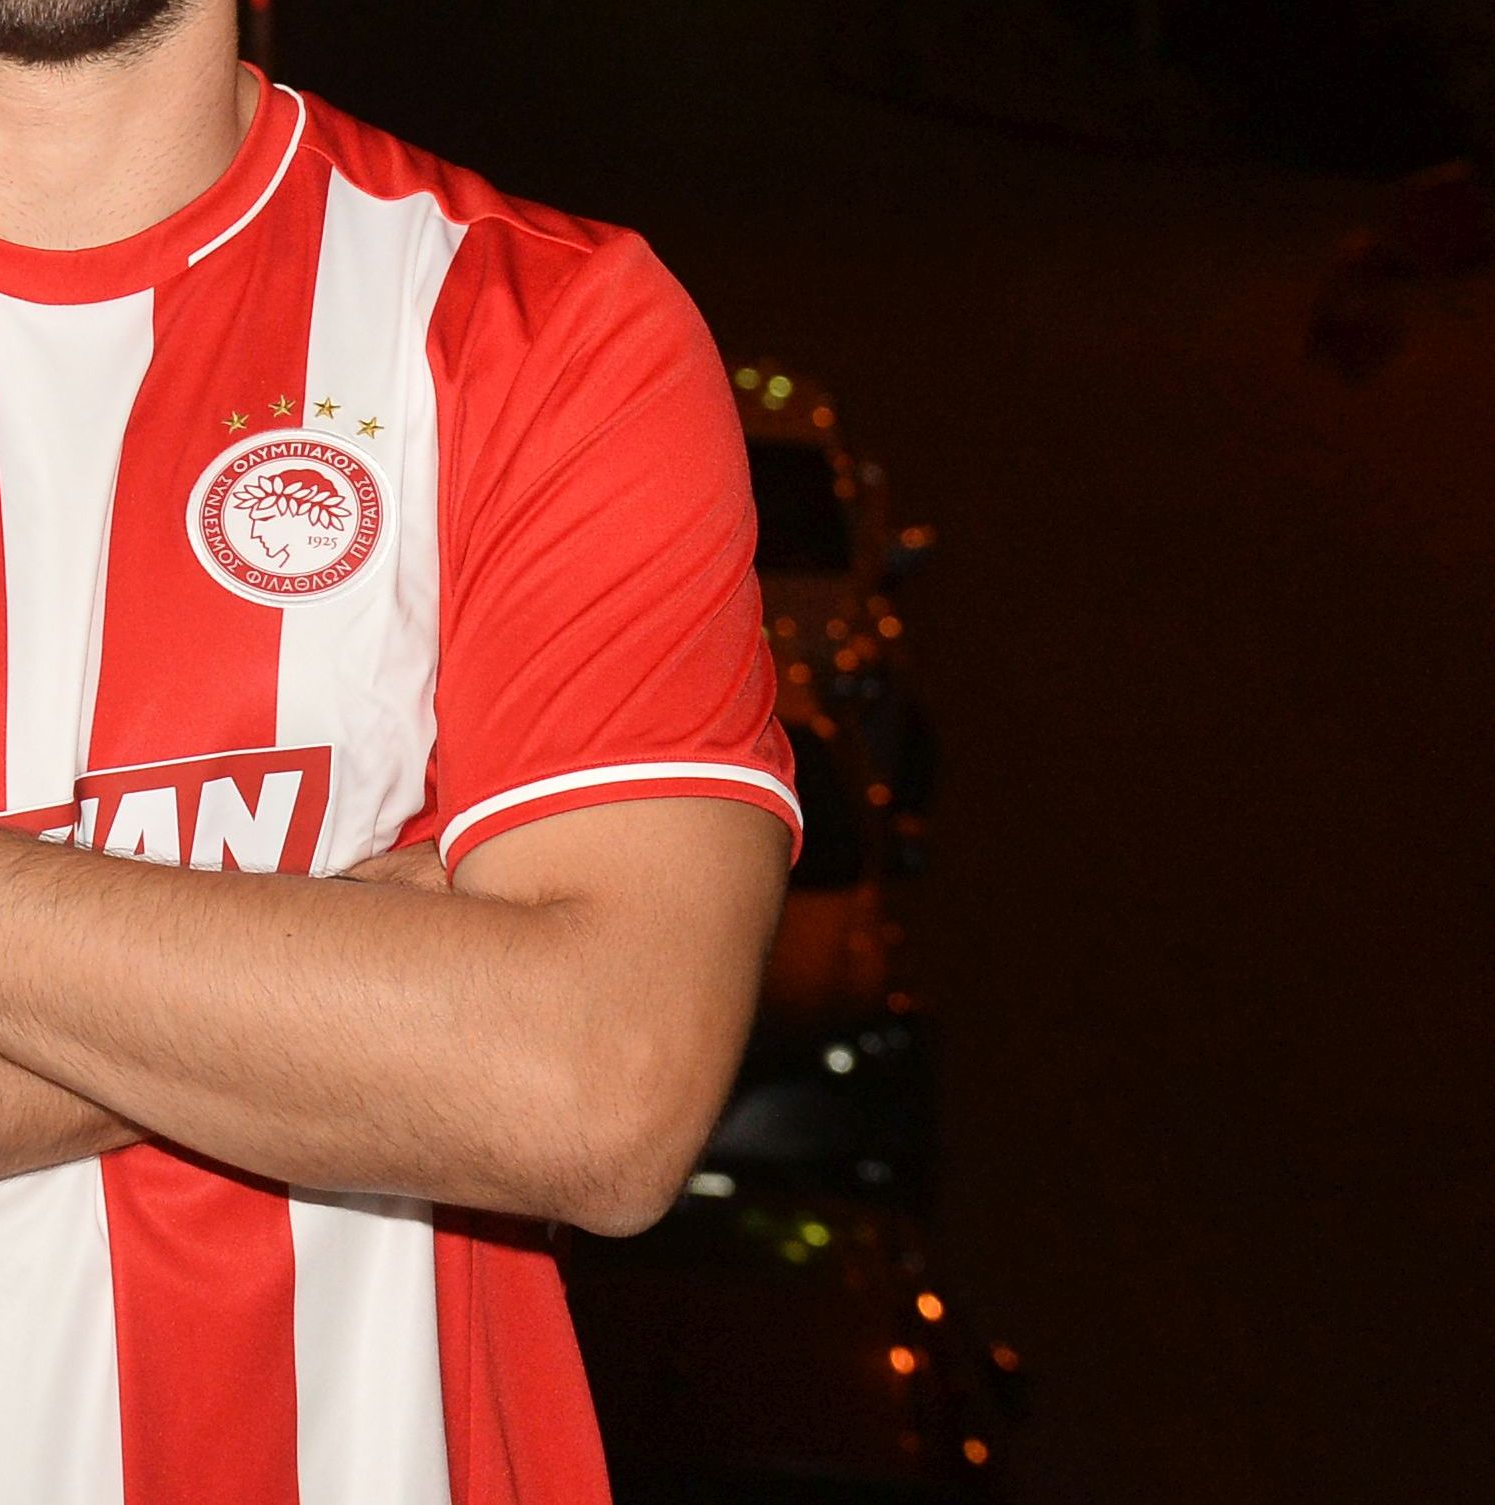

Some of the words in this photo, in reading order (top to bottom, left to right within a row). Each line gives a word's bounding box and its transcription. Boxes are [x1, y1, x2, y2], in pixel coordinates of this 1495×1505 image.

[232, 442, 359, 477] ΟΛΥΜΠΙΑΚΟΣ
[203, 475, 243, 573] ΣΥΝΔΕΣΜΟΣ
[350, 475, 379, 560] ΠΕΙΡΑΙΩΣ
[307, 535, 338, 550] 1925
[245, 559, 353, 592] ΦΙΛΑΘΛΩΝ
